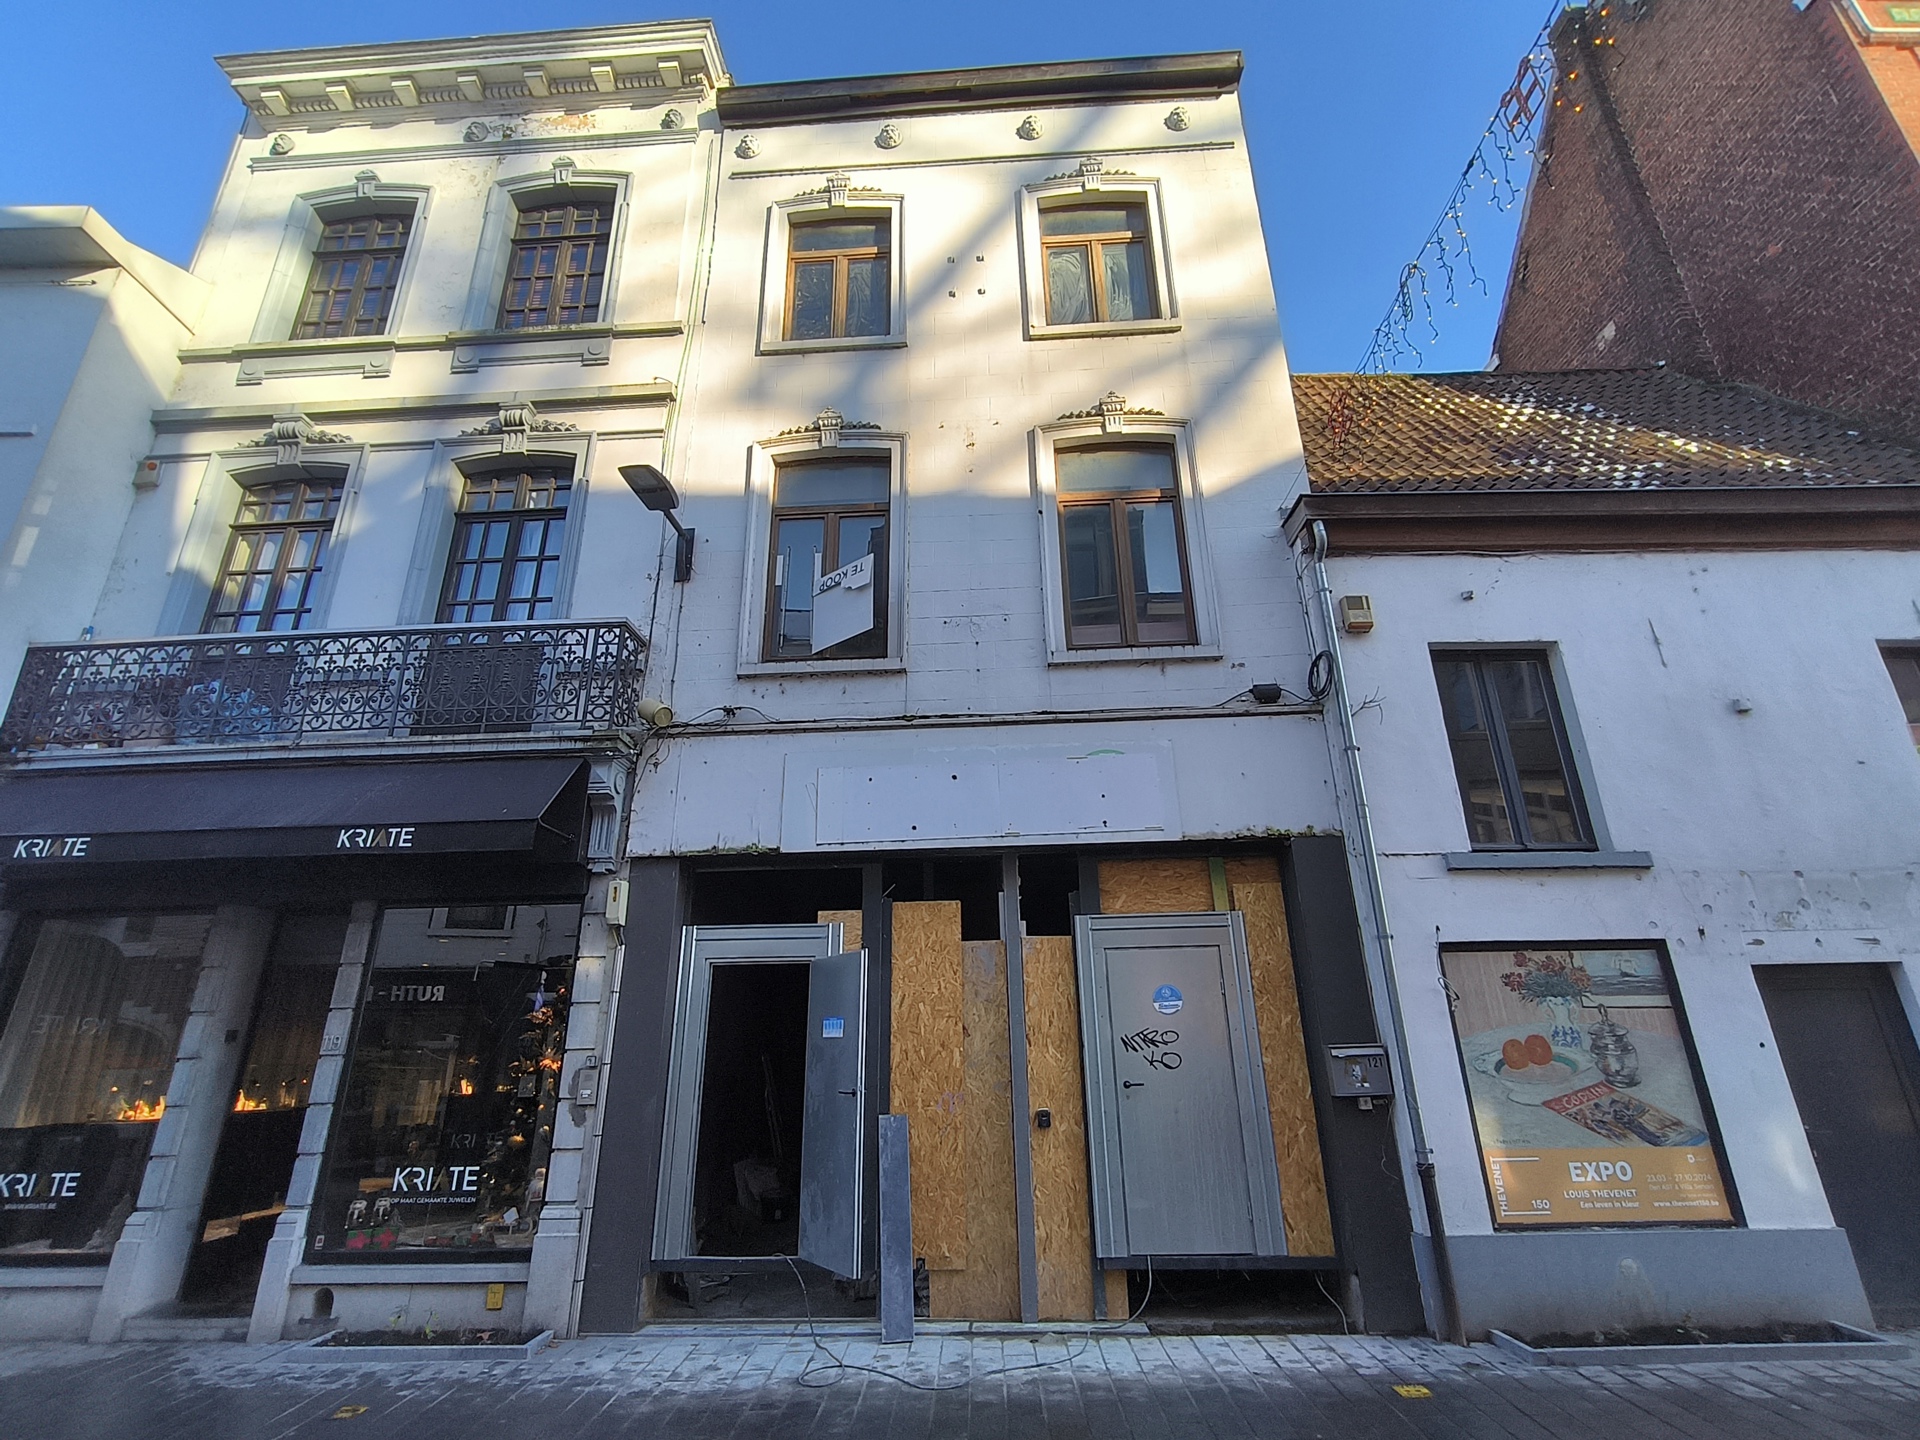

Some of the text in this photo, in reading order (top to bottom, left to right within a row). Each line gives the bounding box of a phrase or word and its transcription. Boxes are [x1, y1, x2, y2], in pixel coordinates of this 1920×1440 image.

[819, 562, 865, 592] TE KOOP
[13, 837, 92, 858] KRIATE
[336, 827, 416, 848] KRIATE
[321, 1035, 342, 1051] 119
[1367, 1057, 1383, 1068] 121
[392, 1166, 480, 1192] KRIATE
[1568, 1161, 1633, 1182] EXPO
[1490, 1156, 1509, 1217] THEVENET
[1563, 1188, 1637, 1199] LOUIS THEVENET
[1531, 1199, 1550, 1209] 150
[1580, 1201, 1594, 1209] Een
